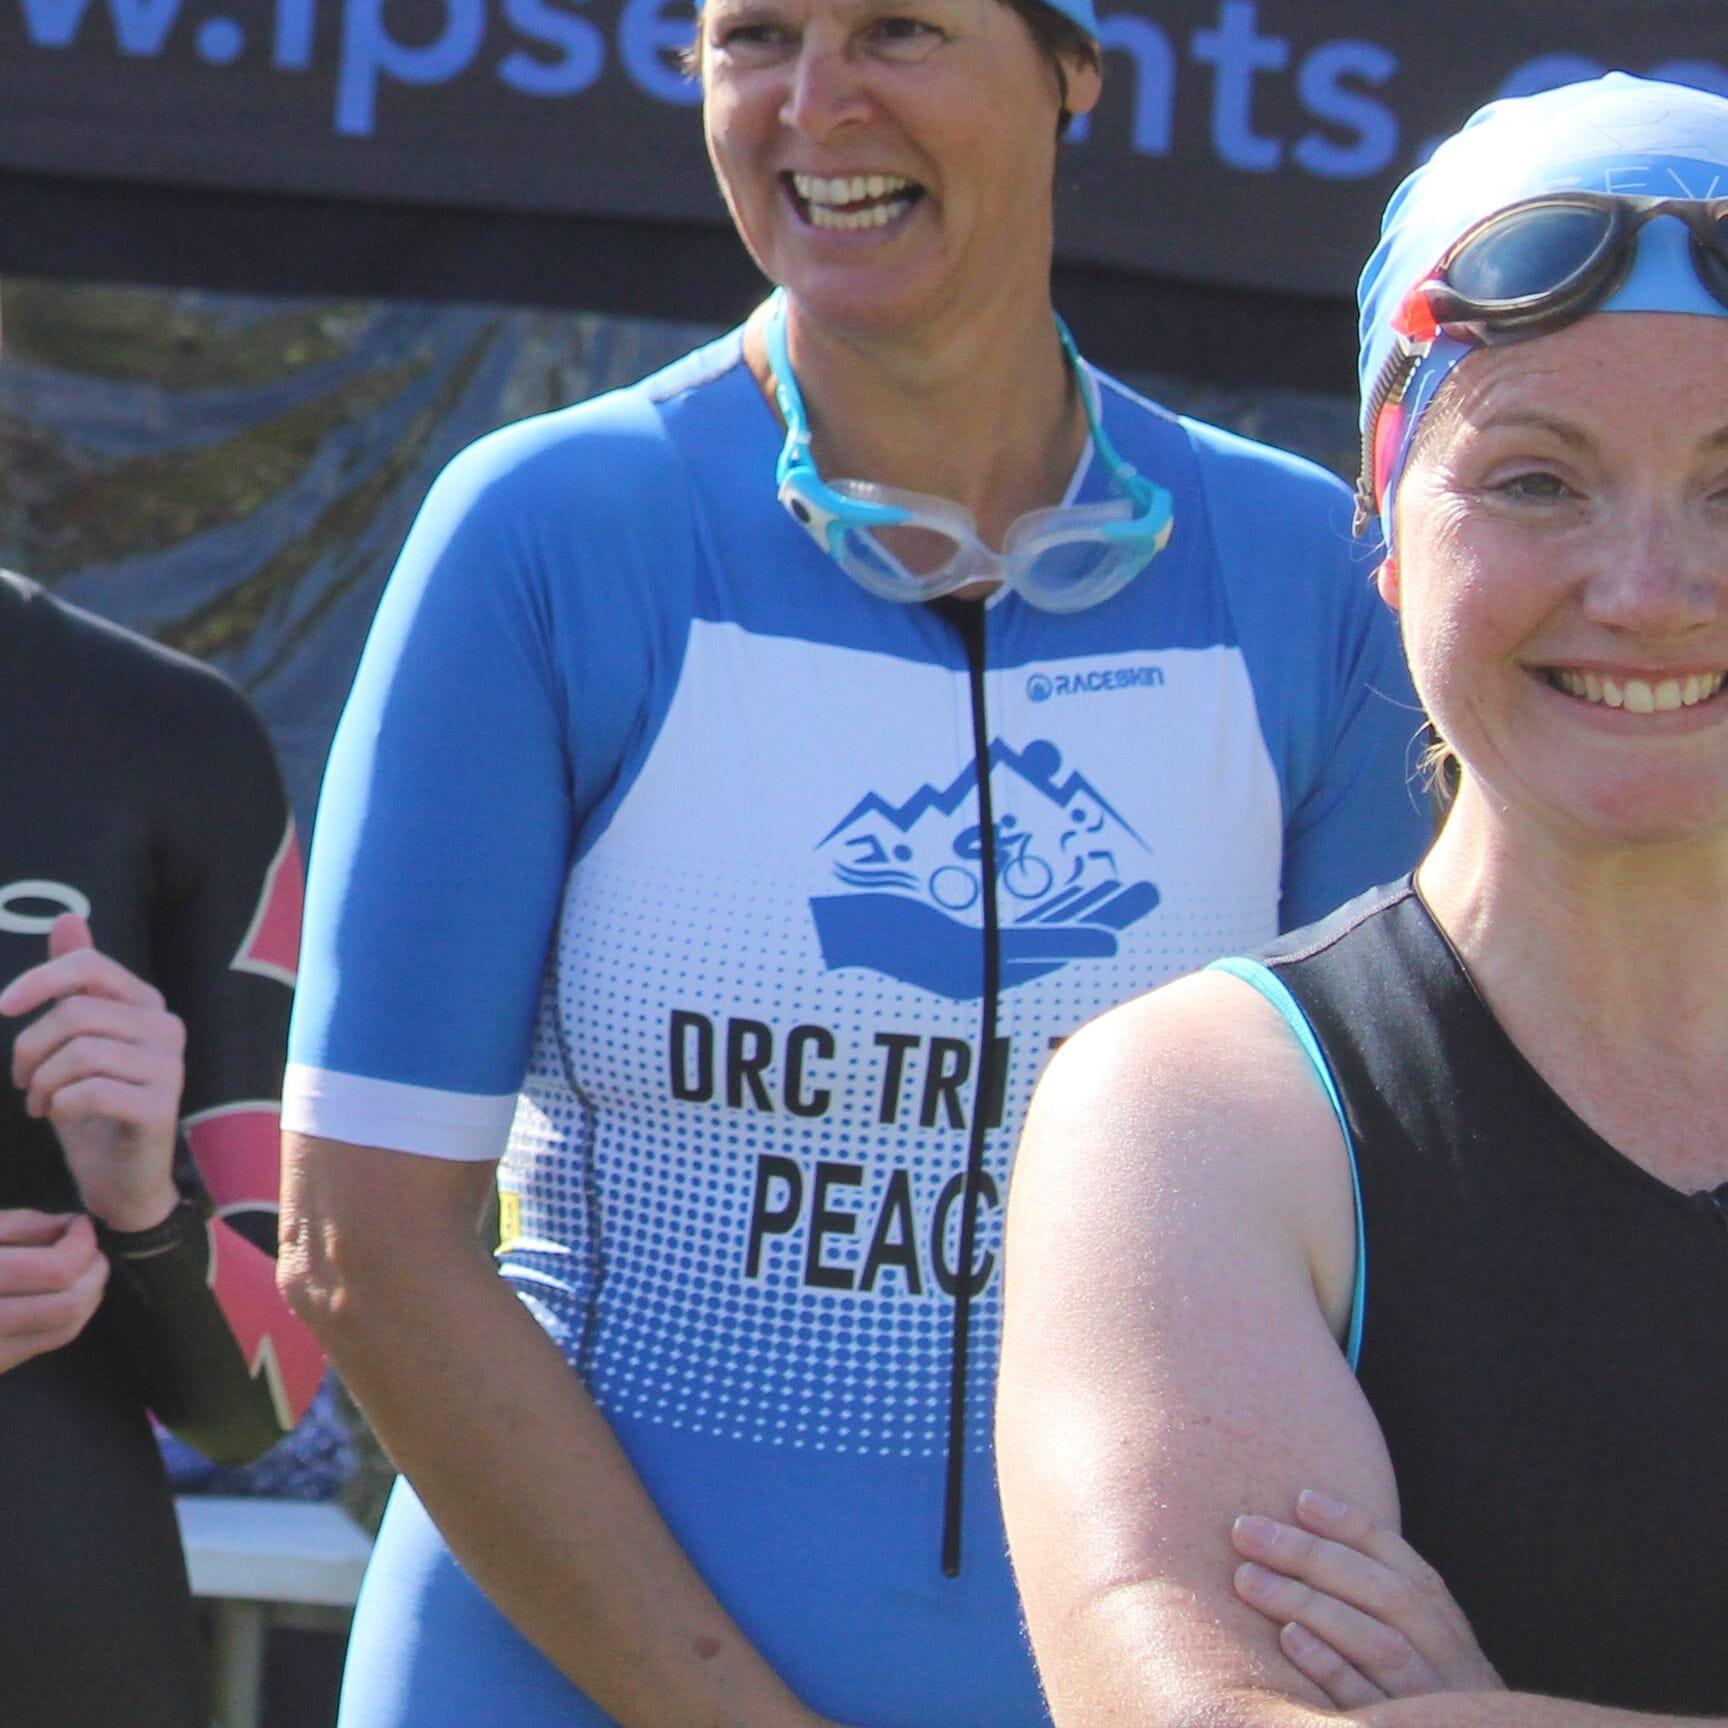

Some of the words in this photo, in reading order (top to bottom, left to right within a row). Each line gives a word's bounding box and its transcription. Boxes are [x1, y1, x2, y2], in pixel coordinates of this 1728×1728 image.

[670, 1009, 835, 1118] DRC
[874, 1032, 1011, 1131] TRI
[745, 1153, 1000, 1299] PEAC
